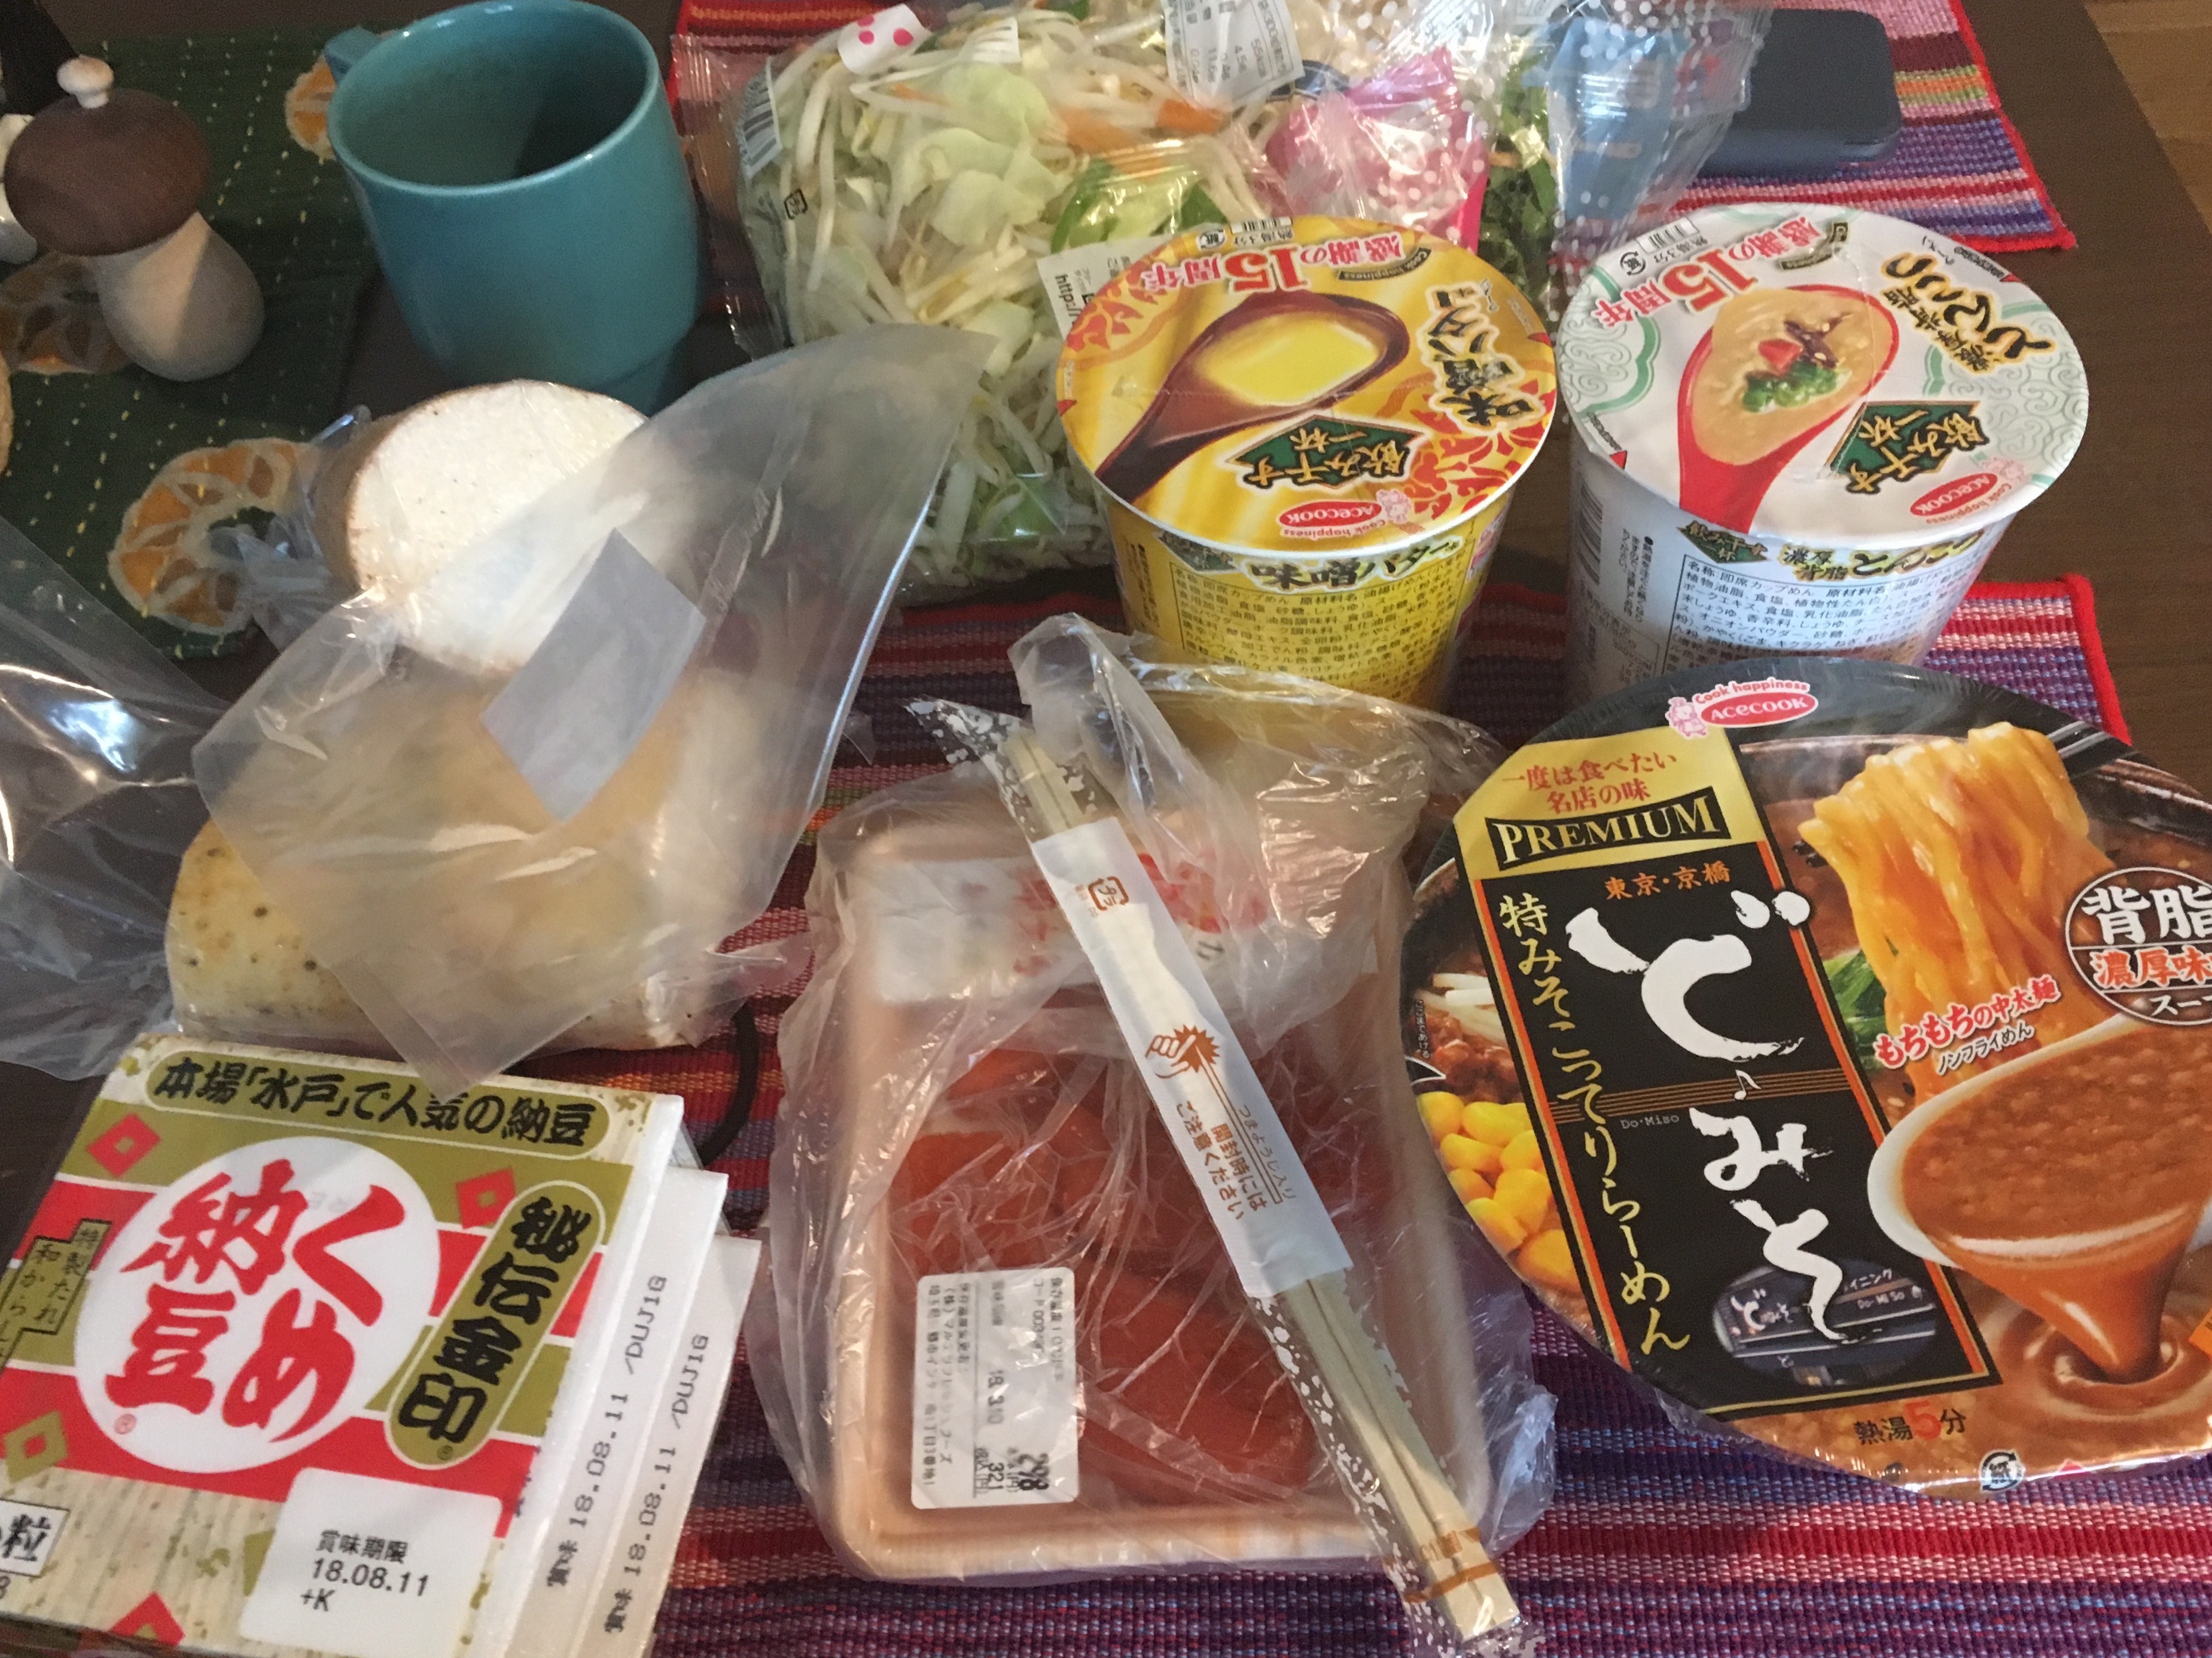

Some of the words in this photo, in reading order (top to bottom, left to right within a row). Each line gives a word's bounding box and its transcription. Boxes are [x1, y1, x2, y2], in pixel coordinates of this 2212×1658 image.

[1885, 254, 2054, 361] とんこつ
[1293, 428, 1371, 455] 一杯
[1846, 409, 1988, 494] 飲み干す
[1859, 409, 1926, 450] 一杯
[1242, 434, 1410, 489] 飲み干す
[1283, 525, 1354, 540] happiness
[1695, 685, 1729, 705] Cook
[1732, 677, 1808, 694] happiness
[1502, 751, 1677, 793] 一度は食べたい
[1546, 778, 1652, 816] 名店の味
[1491, 796, 1721, 864] PREMIUM
[1604, 860, 1731, 901] 東京・京橋
[2082, 885, 2212, 945] 背脂
[1875, 976, 2062, 1069] もちもちの中太麺
[1937, 1022, 2035, 1075] ノンフライめん
[1498, 893, 1691, 1354] 特みそこってりらーめん
[1176, 1100, 1245, 1220] ご注意ください
[1211, 1123, 1268, 1211] 開封時には
[104, 1158, 309, 1415] 納豆
[221, 1184, 406, 1443] くめ
[398, 1196, 592, 1444] 秘伝金印
[1854, 1400, 1967, 1446] 熱湯5分
[569, 1392, 629, 1529] 18.08.11
[989, 1461, 1005, 1491] 321
[623, 1445, 677, 1578] 18.08.11
[314, 1528, 410, 1565] 賞味期限
[299, 1588, 335, 1613] +K
[311, 1558, 430, 1598] 18.08.11
